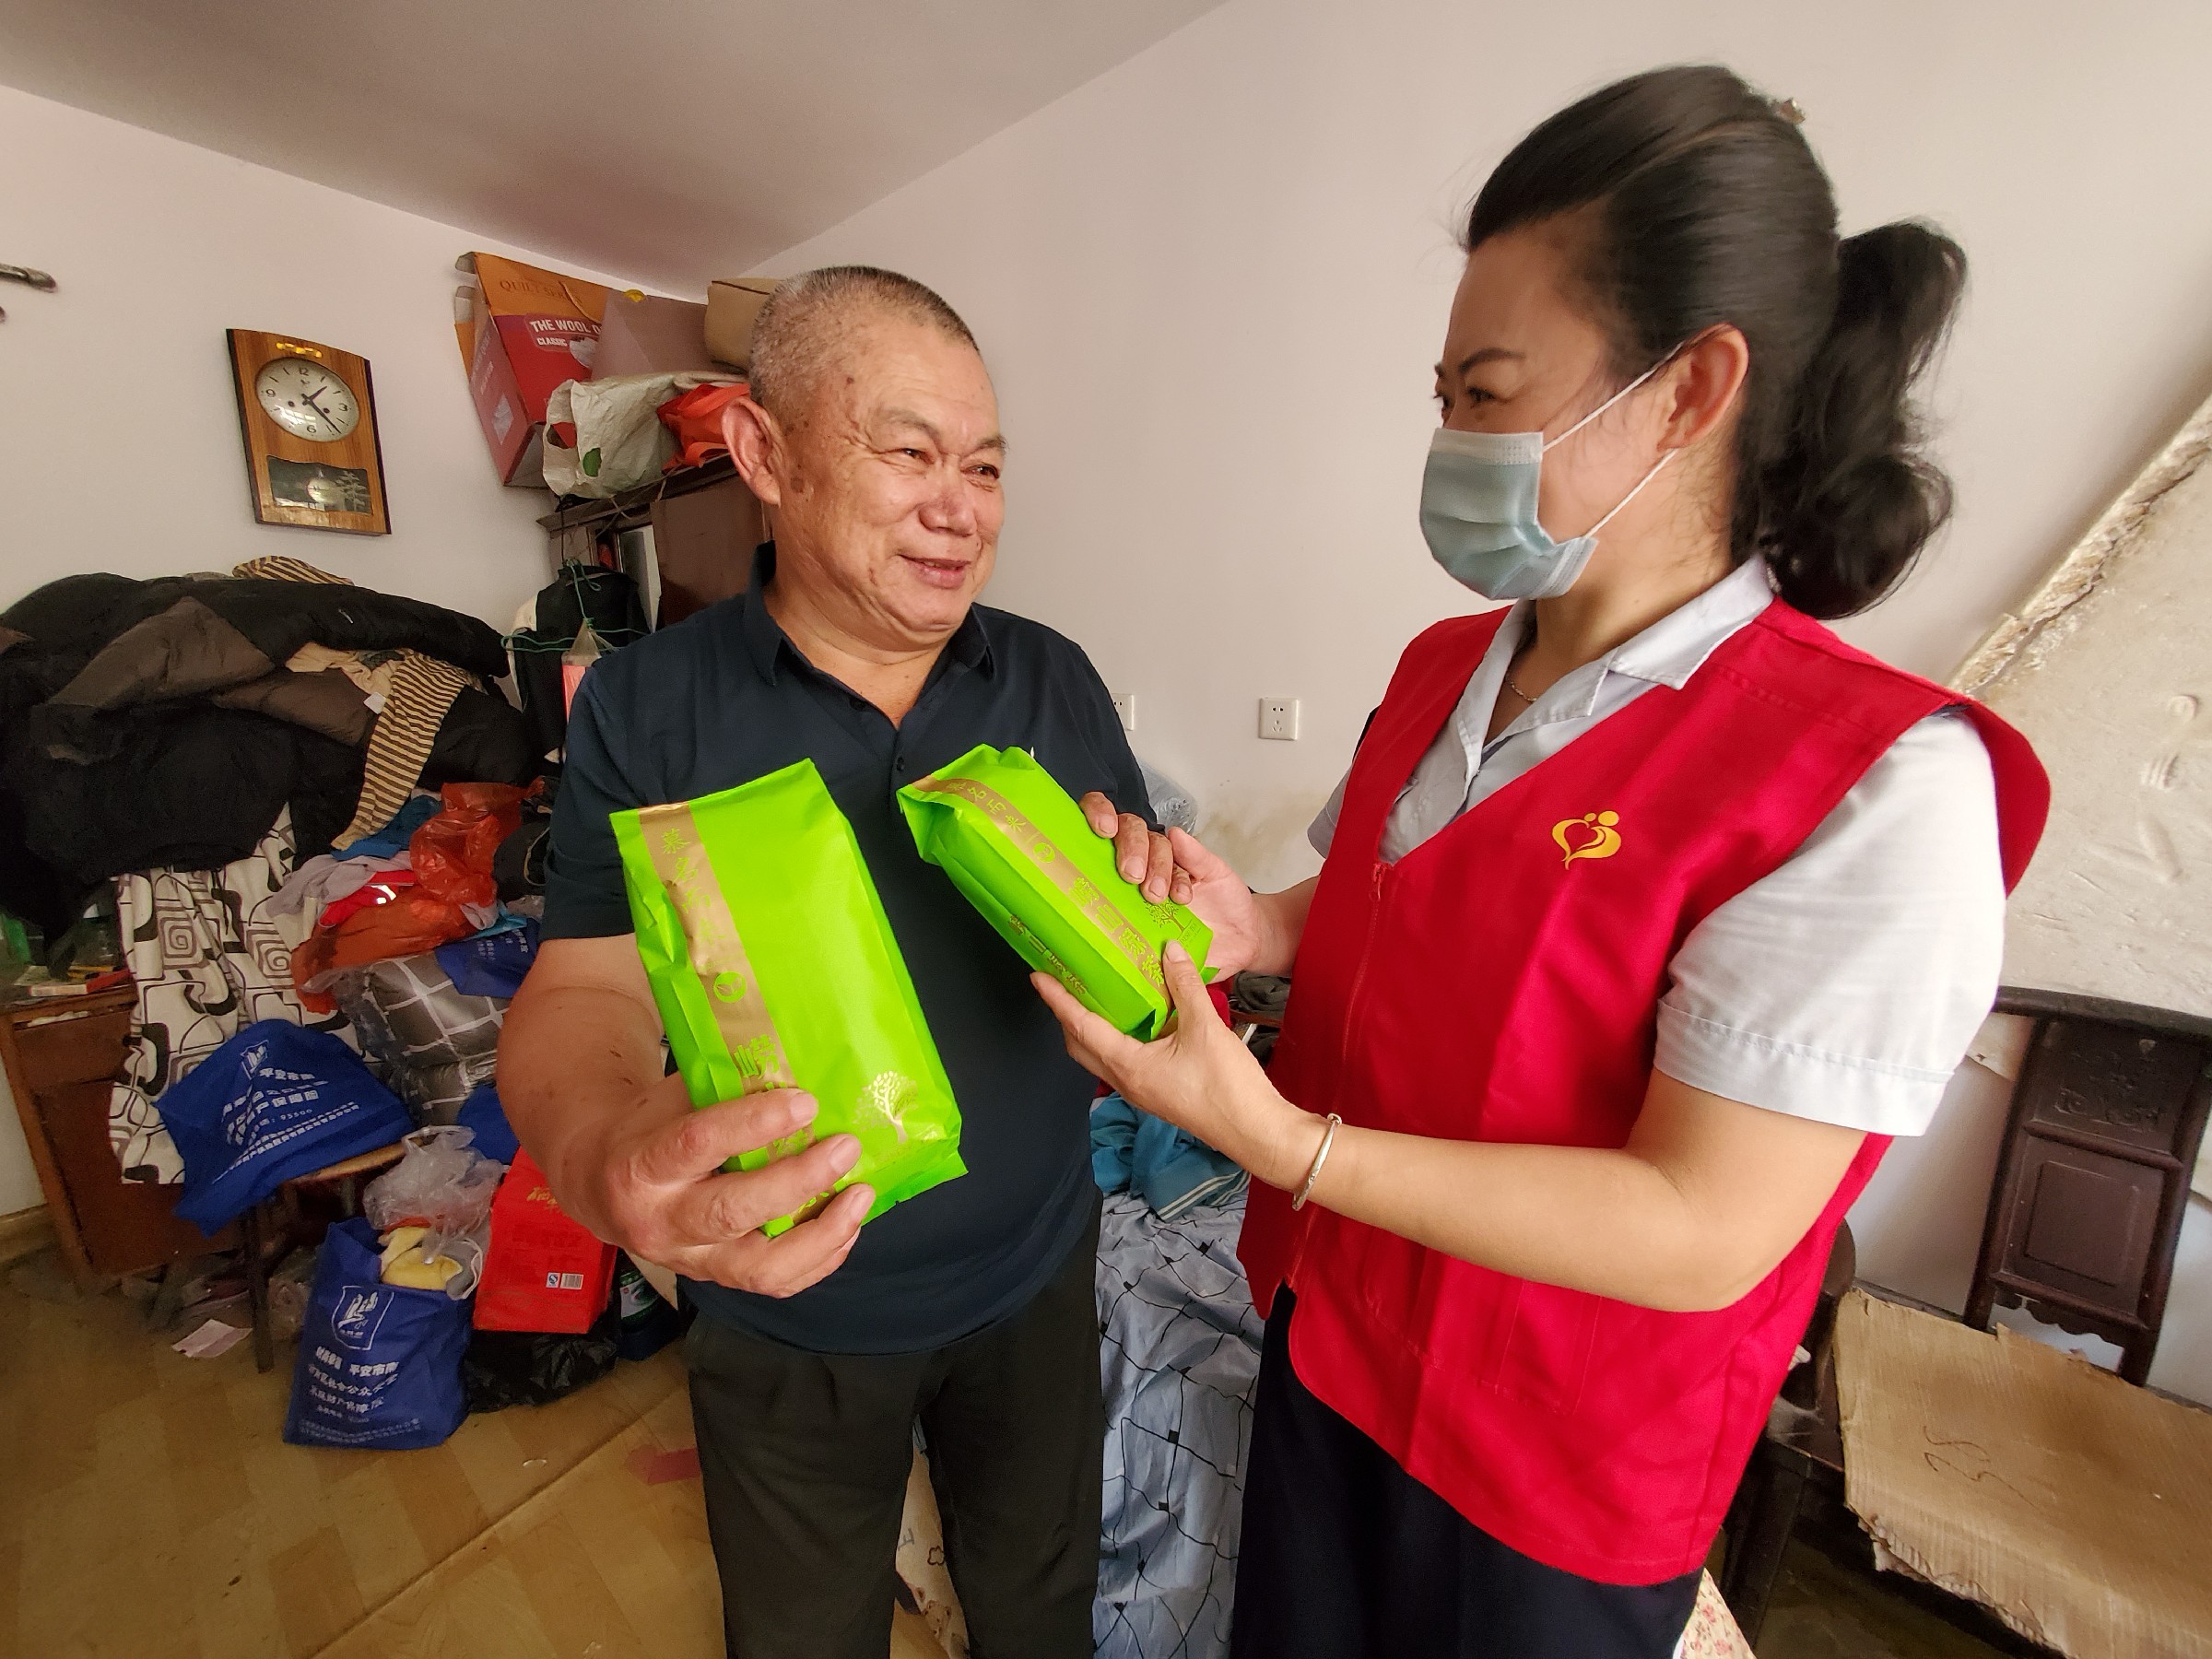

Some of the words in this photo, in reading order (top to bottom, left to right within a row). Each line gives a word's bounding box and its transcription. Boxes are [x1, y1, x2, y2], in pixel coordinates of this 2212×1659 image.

[529, 319, 556, 333] THE
[555, 319, 592, 334] WOOL
[536, 337, 568, 347] CLASSIC
